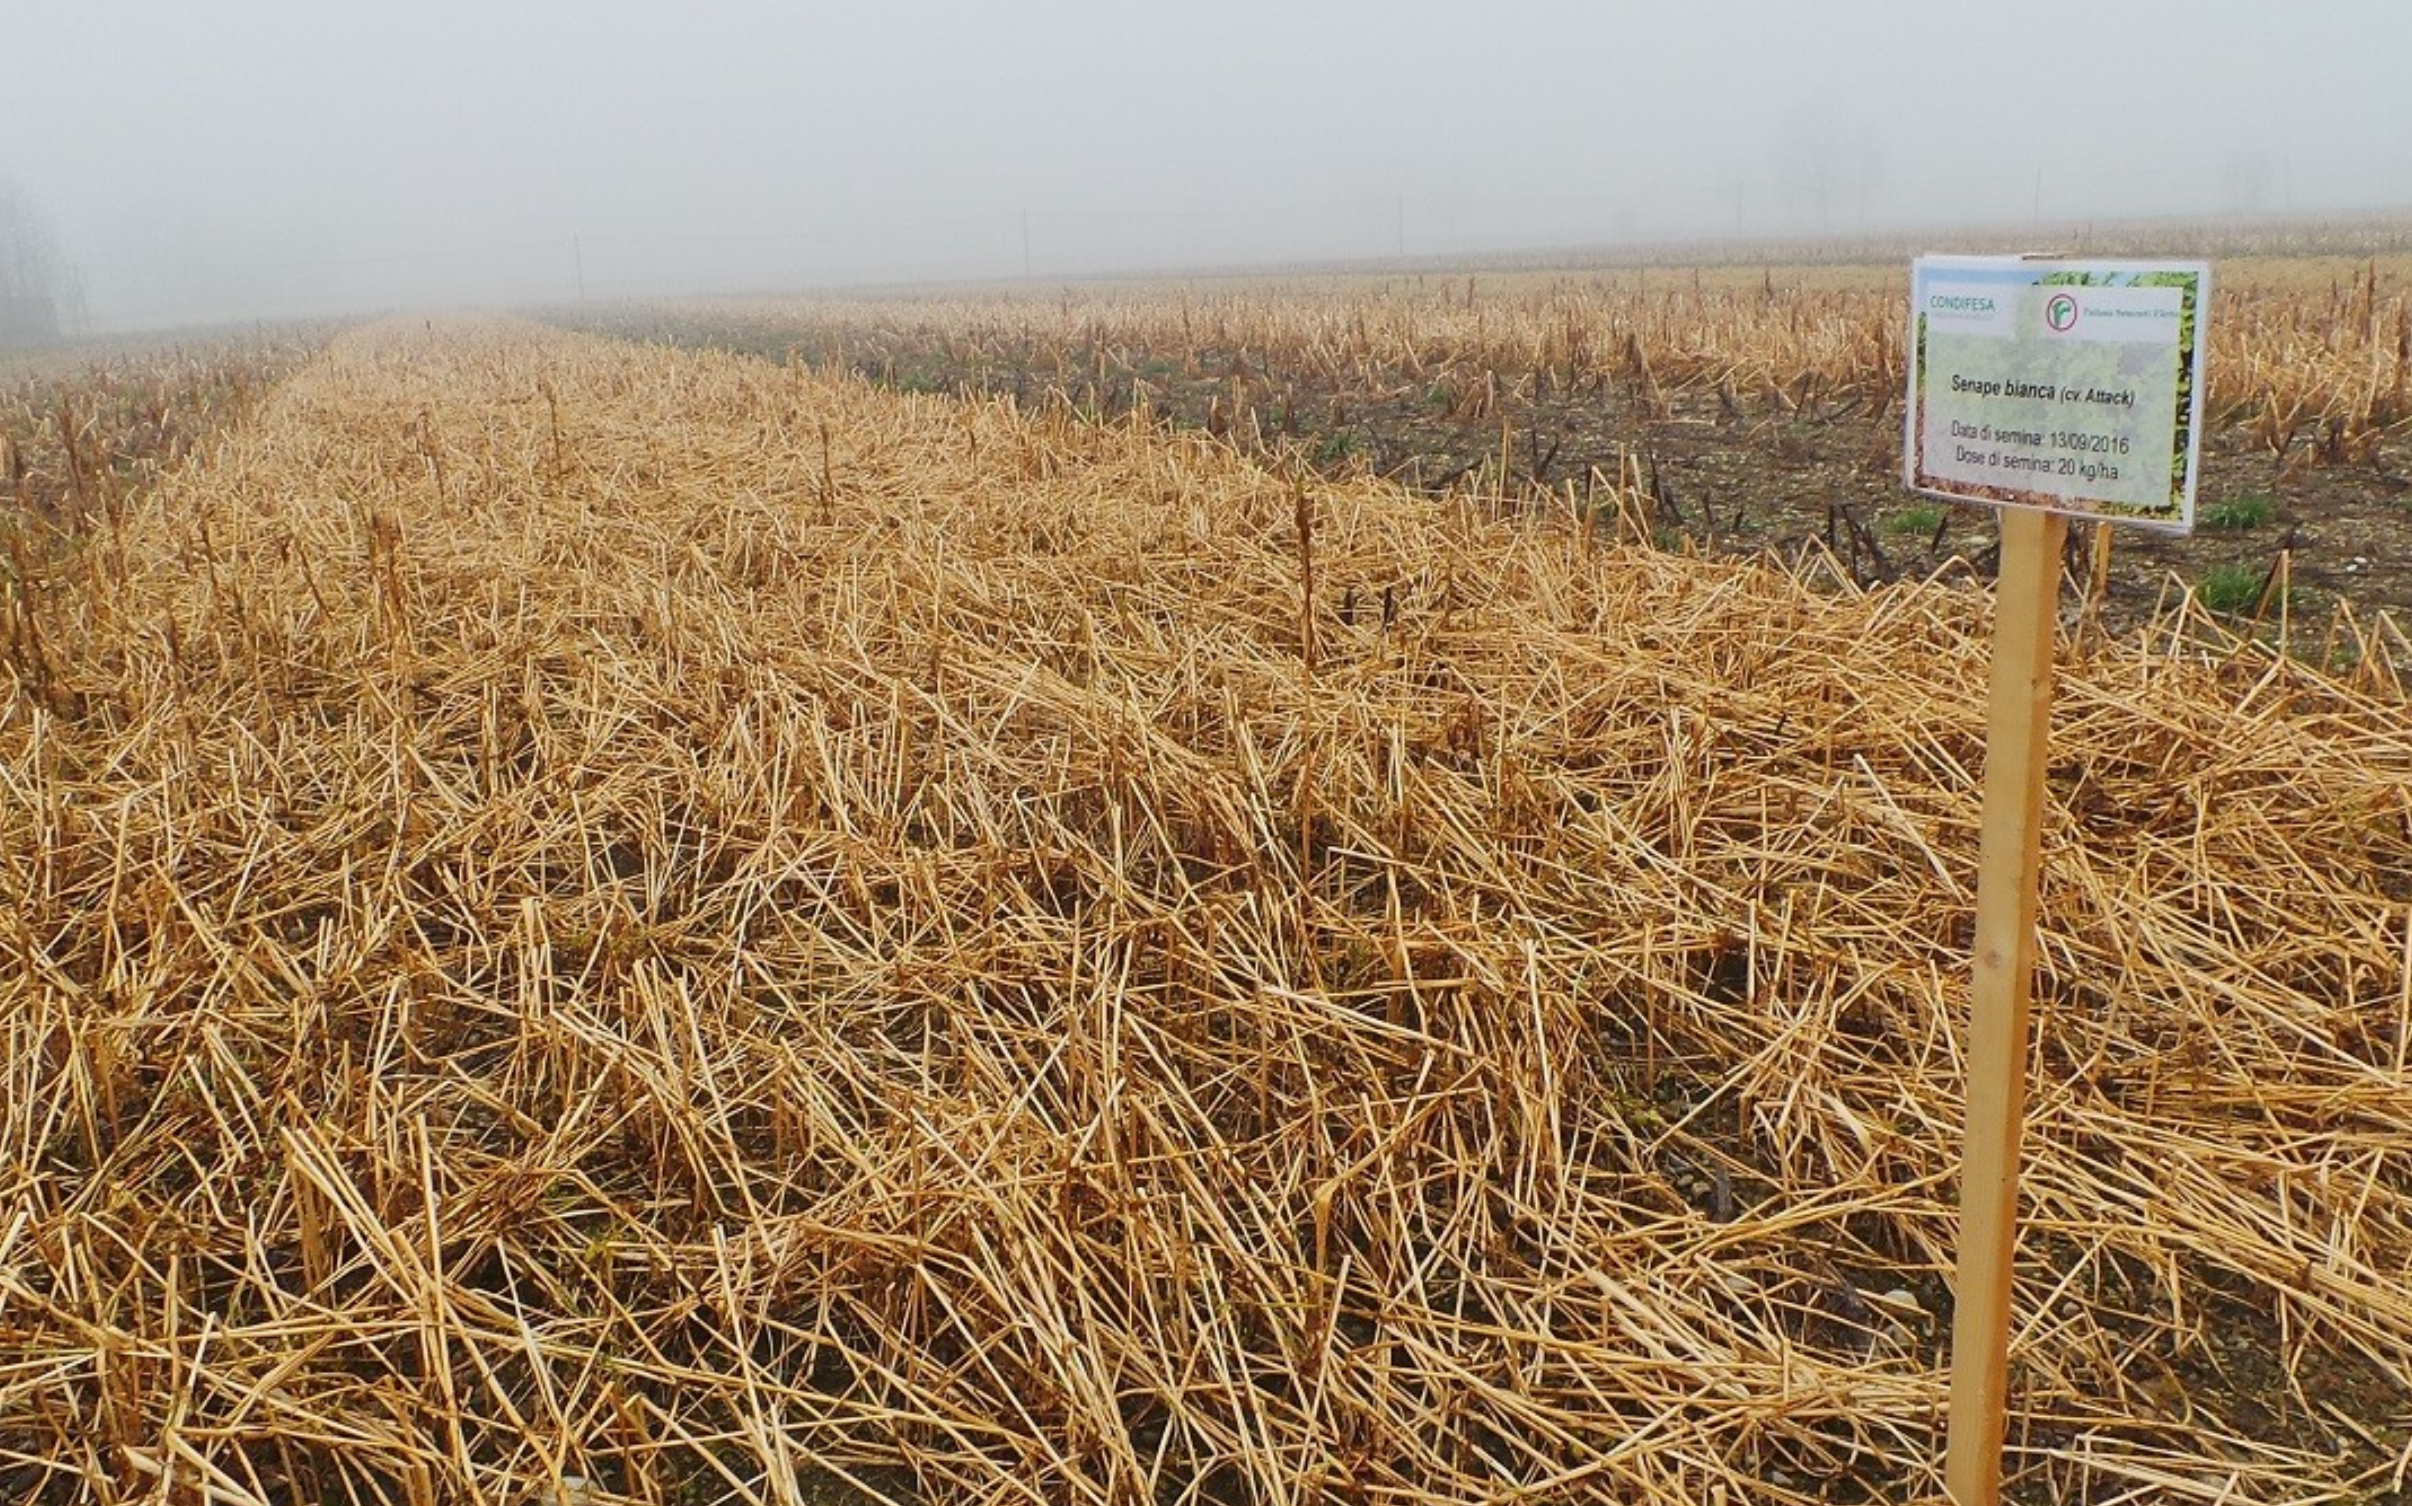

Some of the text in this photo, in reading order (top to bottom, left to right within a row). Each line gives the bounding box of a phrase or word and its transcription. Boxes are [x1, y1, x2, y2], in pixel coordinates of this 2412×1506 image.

[1930, 295, 1996, 312] CONDIFESA
[1952, 374, 2001, 398] Senape
[2004, 378, 2055, 400] bianca
[2085, 388, 2135, 409] Attack)
[1951, 420, 2131, 455] Data di semina: 13/09/2016
[1956, 445, 2119, 482] Dose di semina: 20 kg/ha
